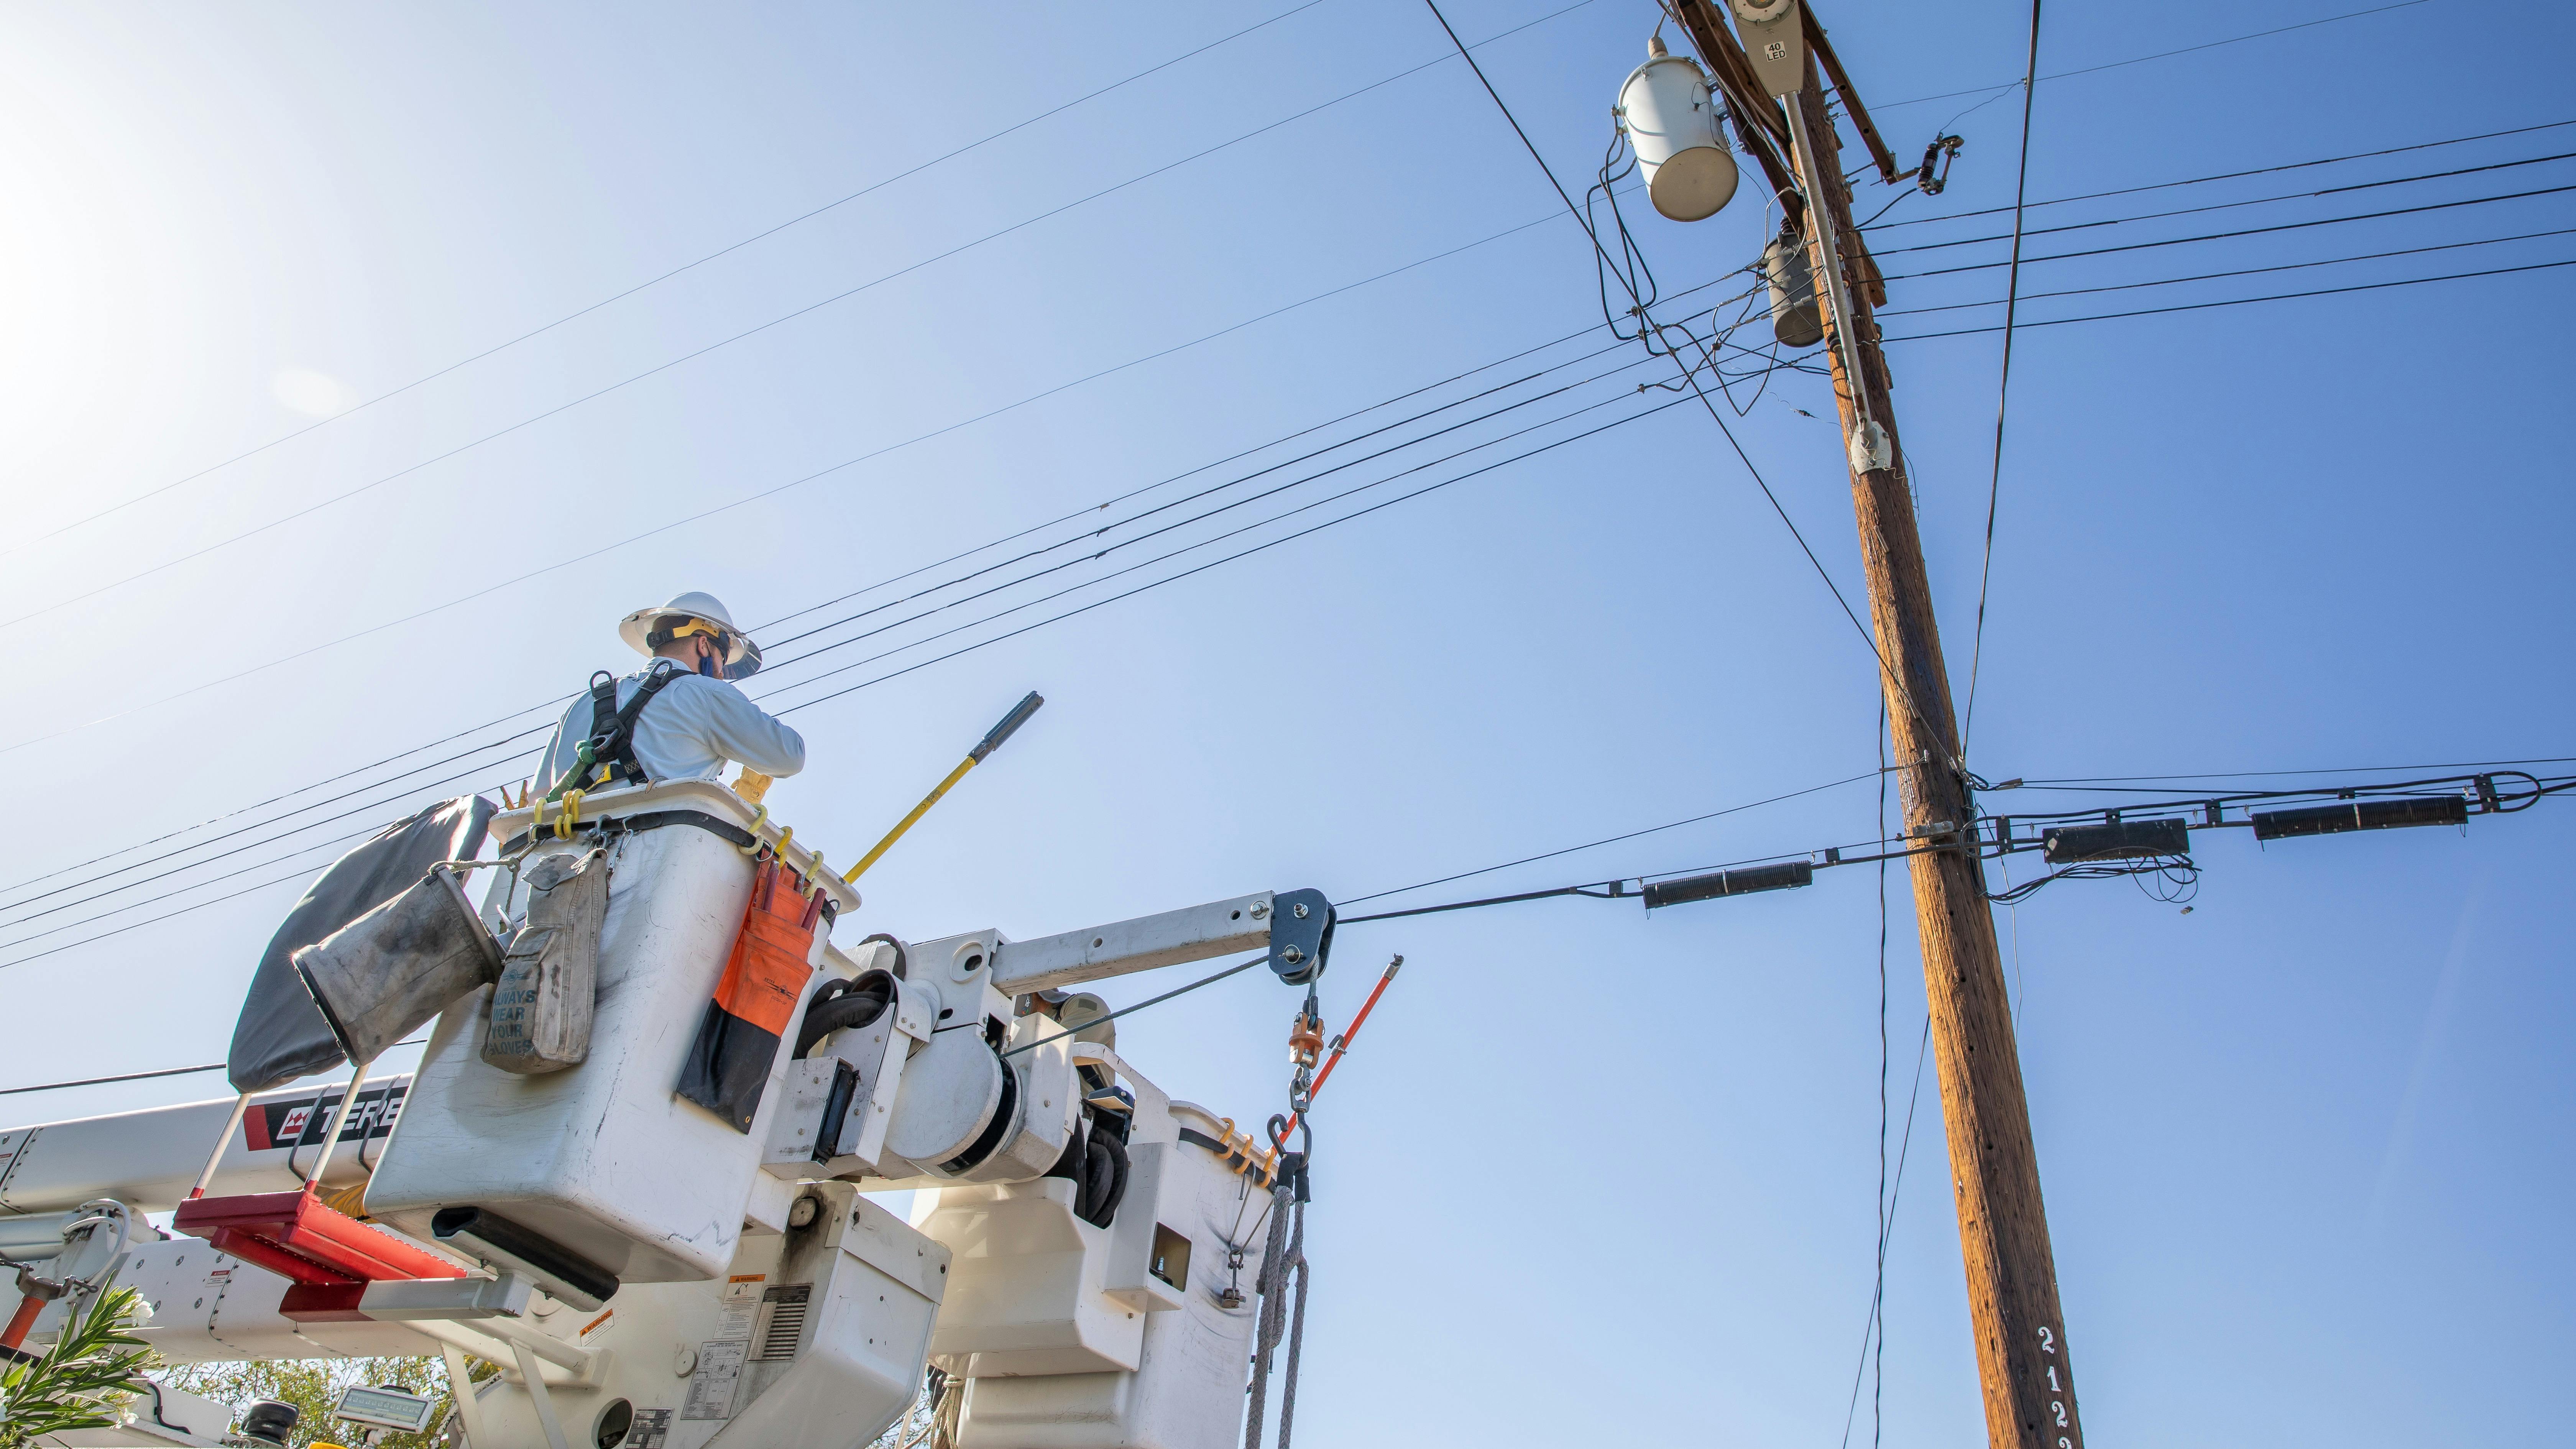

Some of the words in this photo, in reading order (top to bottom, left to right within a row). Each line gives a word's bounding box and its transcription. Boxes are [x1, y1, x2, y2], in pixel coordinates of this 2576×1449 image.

[1769, 43, 1781, 51] 40
[1767, 50, 1785, 61] LED
[494, 989, 536, 1006] ALWAYS
[493, 1007, 525, 1022] WEAR
[492, 1024, 522, 1039] YOUR
[587, 1312, 611, 1331] WARNING
